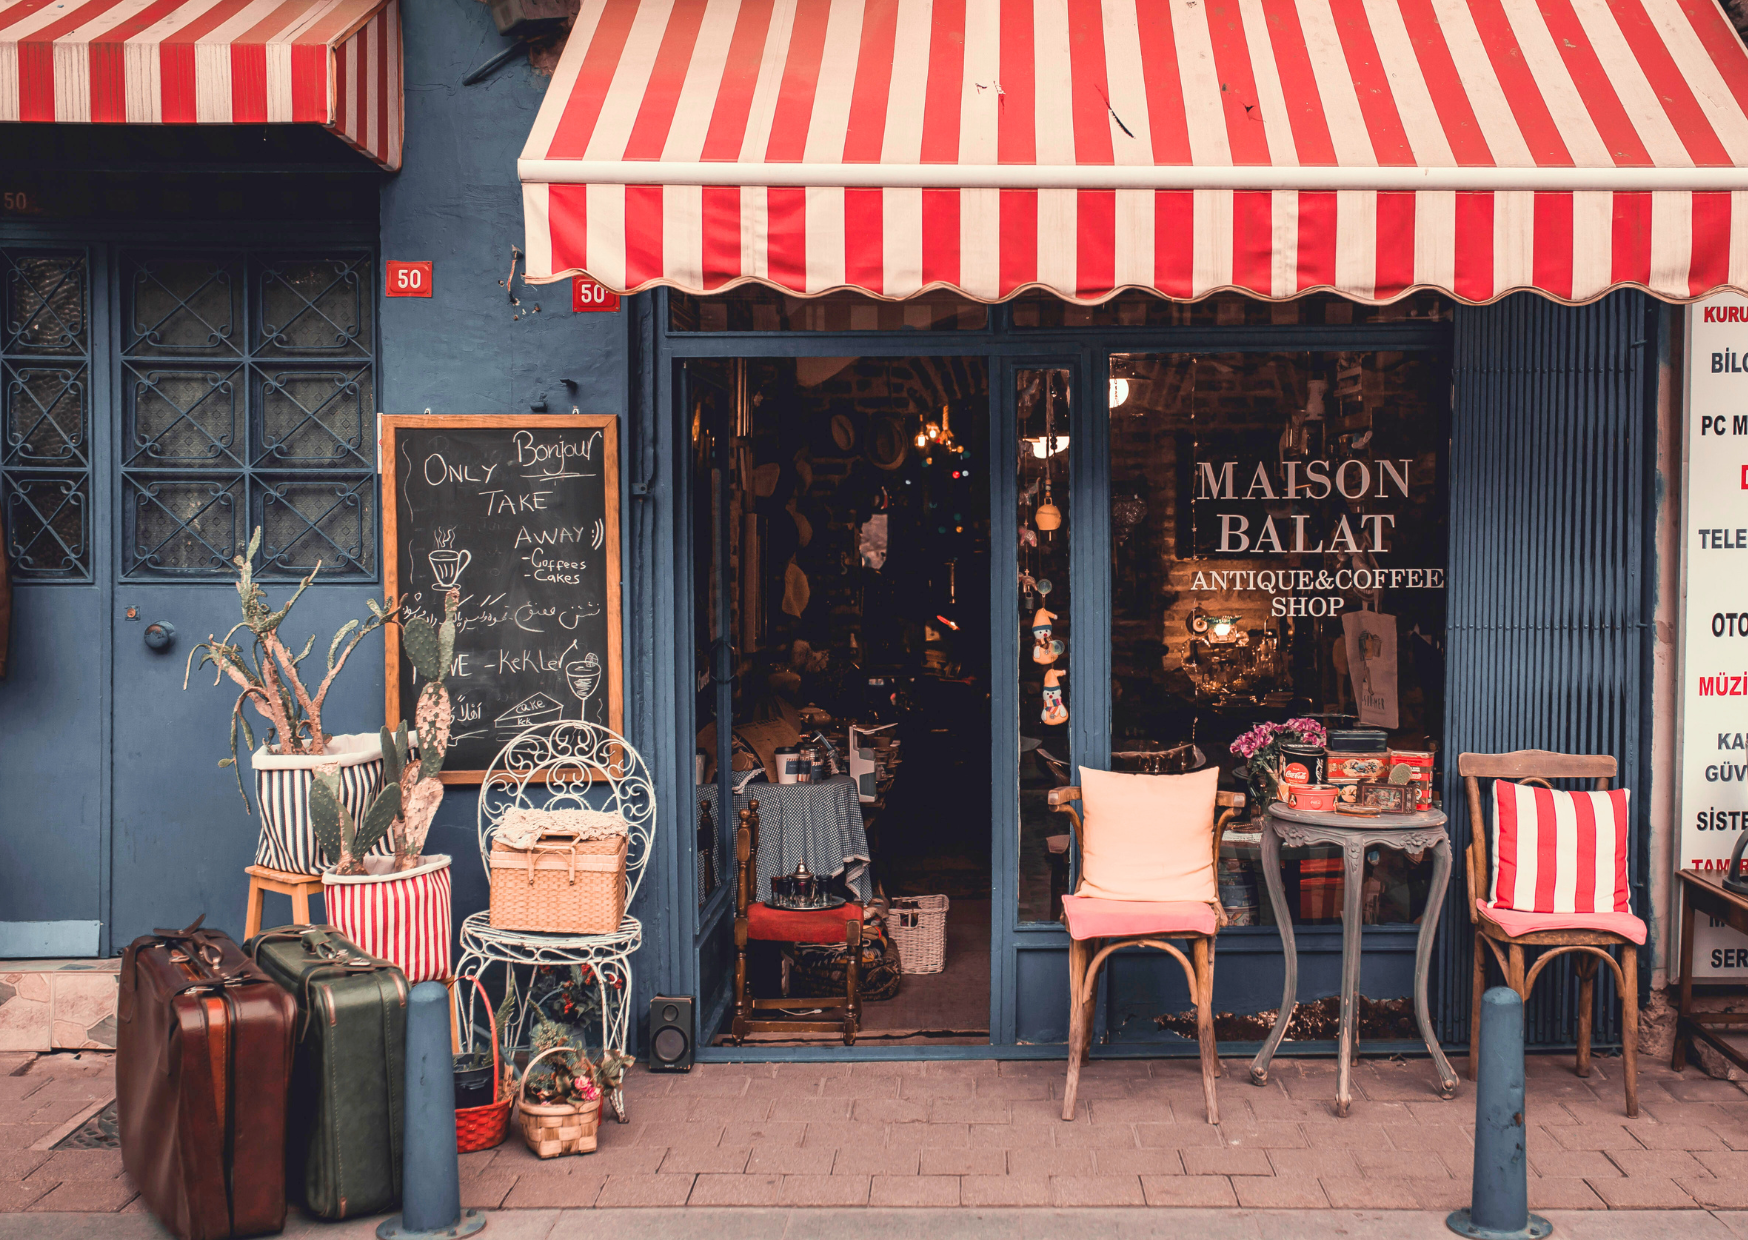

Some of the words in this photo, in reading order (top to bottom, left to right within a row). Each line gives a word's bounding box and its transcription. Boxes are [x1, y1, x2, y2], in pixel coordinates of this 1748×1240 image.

[4, 192, 26, 210] 50
[397, 269, 421, 289] 50
[1701, 415, 1726, 436] PC
[513, 430, 602, 476] Bonjour
[424, 453, 497, 485] ONLY
[1197, 459, 1413, 500] MAISON
[478, 490, 553, 516] TAKE
[514, 526, 583, 548] AWAY
[1215, 514, 1395, 553] BALAT
[1698, 529, 1748, 549] TELE
[1190, 569, 1444, 593] ANTIQUE&COFFEE
[1271, 597, 1345, 617] SHOP
[1699, 671, 1748, 696] MÜZİ
[1711, 948, 1748, 968] SER
